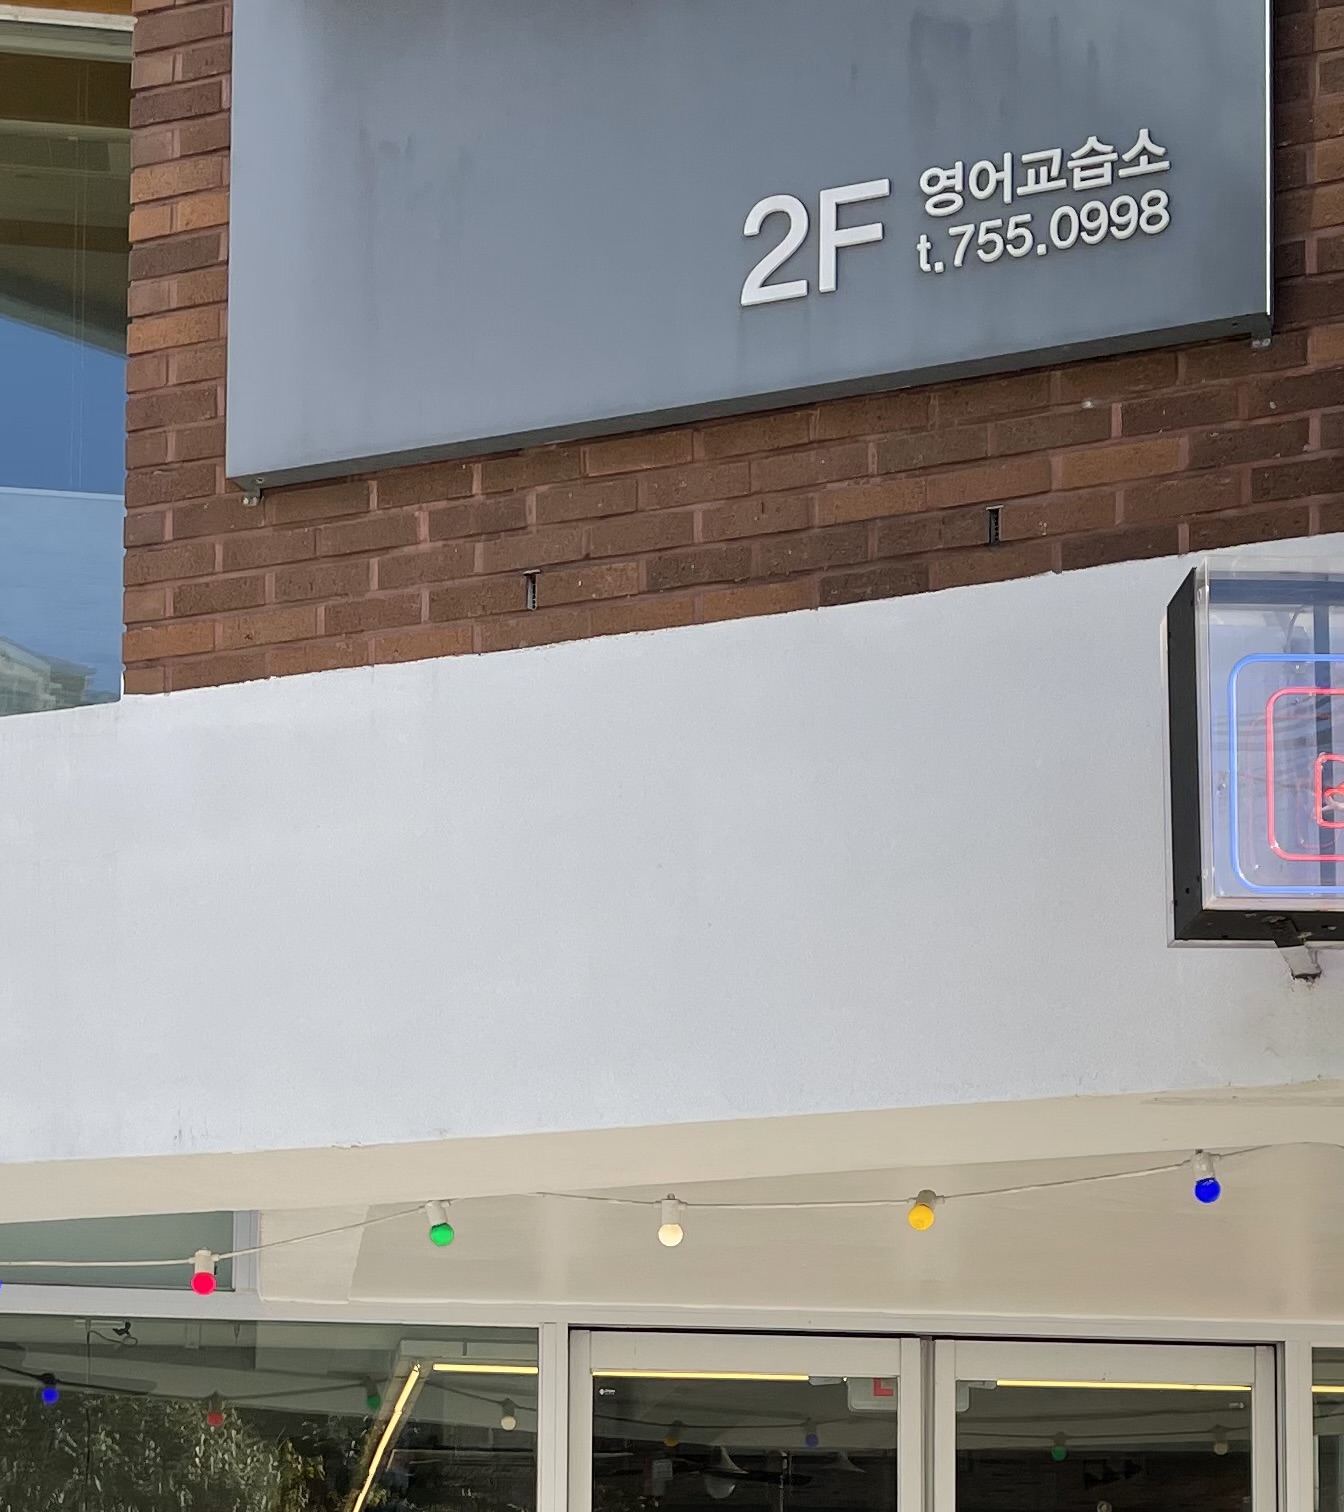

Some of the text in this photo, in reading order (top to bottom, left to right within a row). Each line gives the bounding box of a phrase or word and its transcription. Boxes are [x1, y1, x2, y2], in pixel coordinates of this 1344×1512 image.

[918, 128, 1171, 218] 영어교습소
[740, 178, 891, 307] 2F
[916, 189, 1171, 274] t.755.0998
